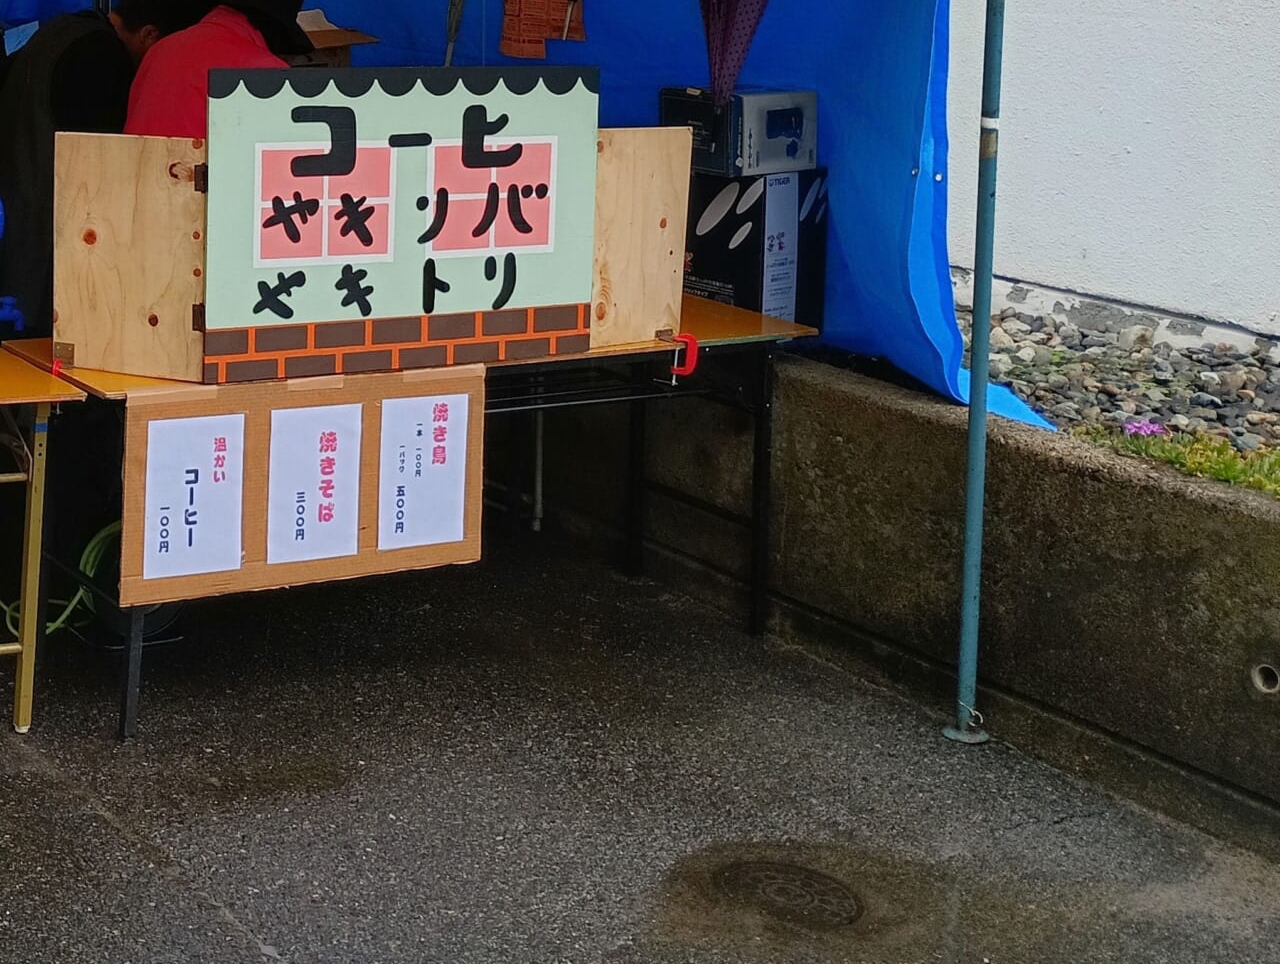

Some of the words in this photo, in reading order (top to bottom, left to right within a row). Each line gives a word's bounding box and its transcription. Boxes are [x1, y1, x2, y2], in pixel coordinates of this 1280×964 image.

[213, 437, 227, 483] 温かい
[432, 402, 448, 465] 焼き鳥
[184, 468, 199, 547] コーヒー
[318, 431, 338, 523] 焼きそば
